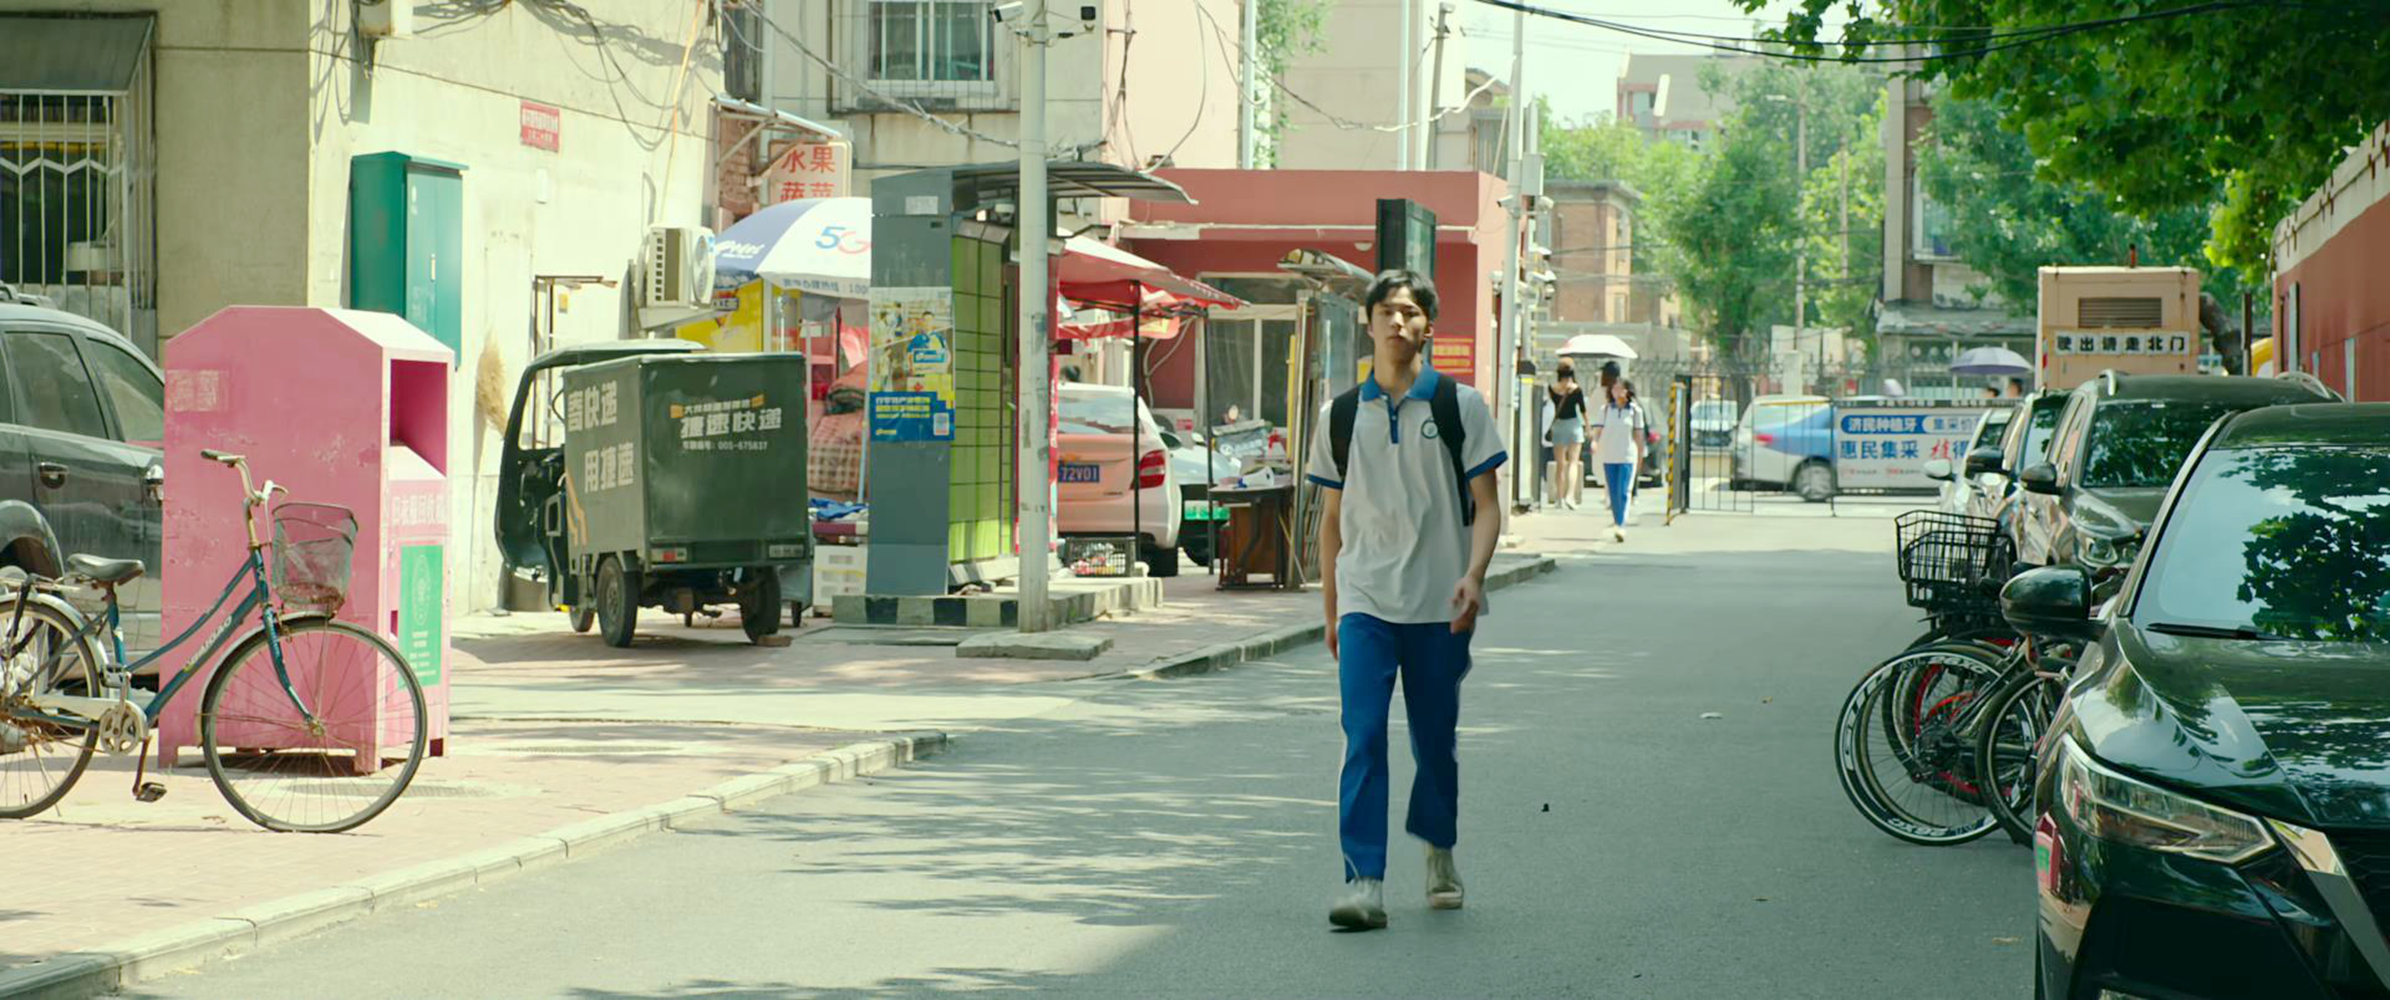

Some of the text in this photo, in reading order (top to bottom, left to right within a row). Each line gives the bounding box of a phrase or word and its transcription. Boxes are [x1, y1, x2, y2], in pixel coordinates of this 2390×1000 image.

[781, 146, 836, 173] 水果
[815, 226, 871, 254] 5G
[2056, 336, 2185, 351] 驶出请走北门
[1849, 417, 1980, 432] 济民种植牙 集采价
[1840, 440, 1919, 459] 惠民集采
